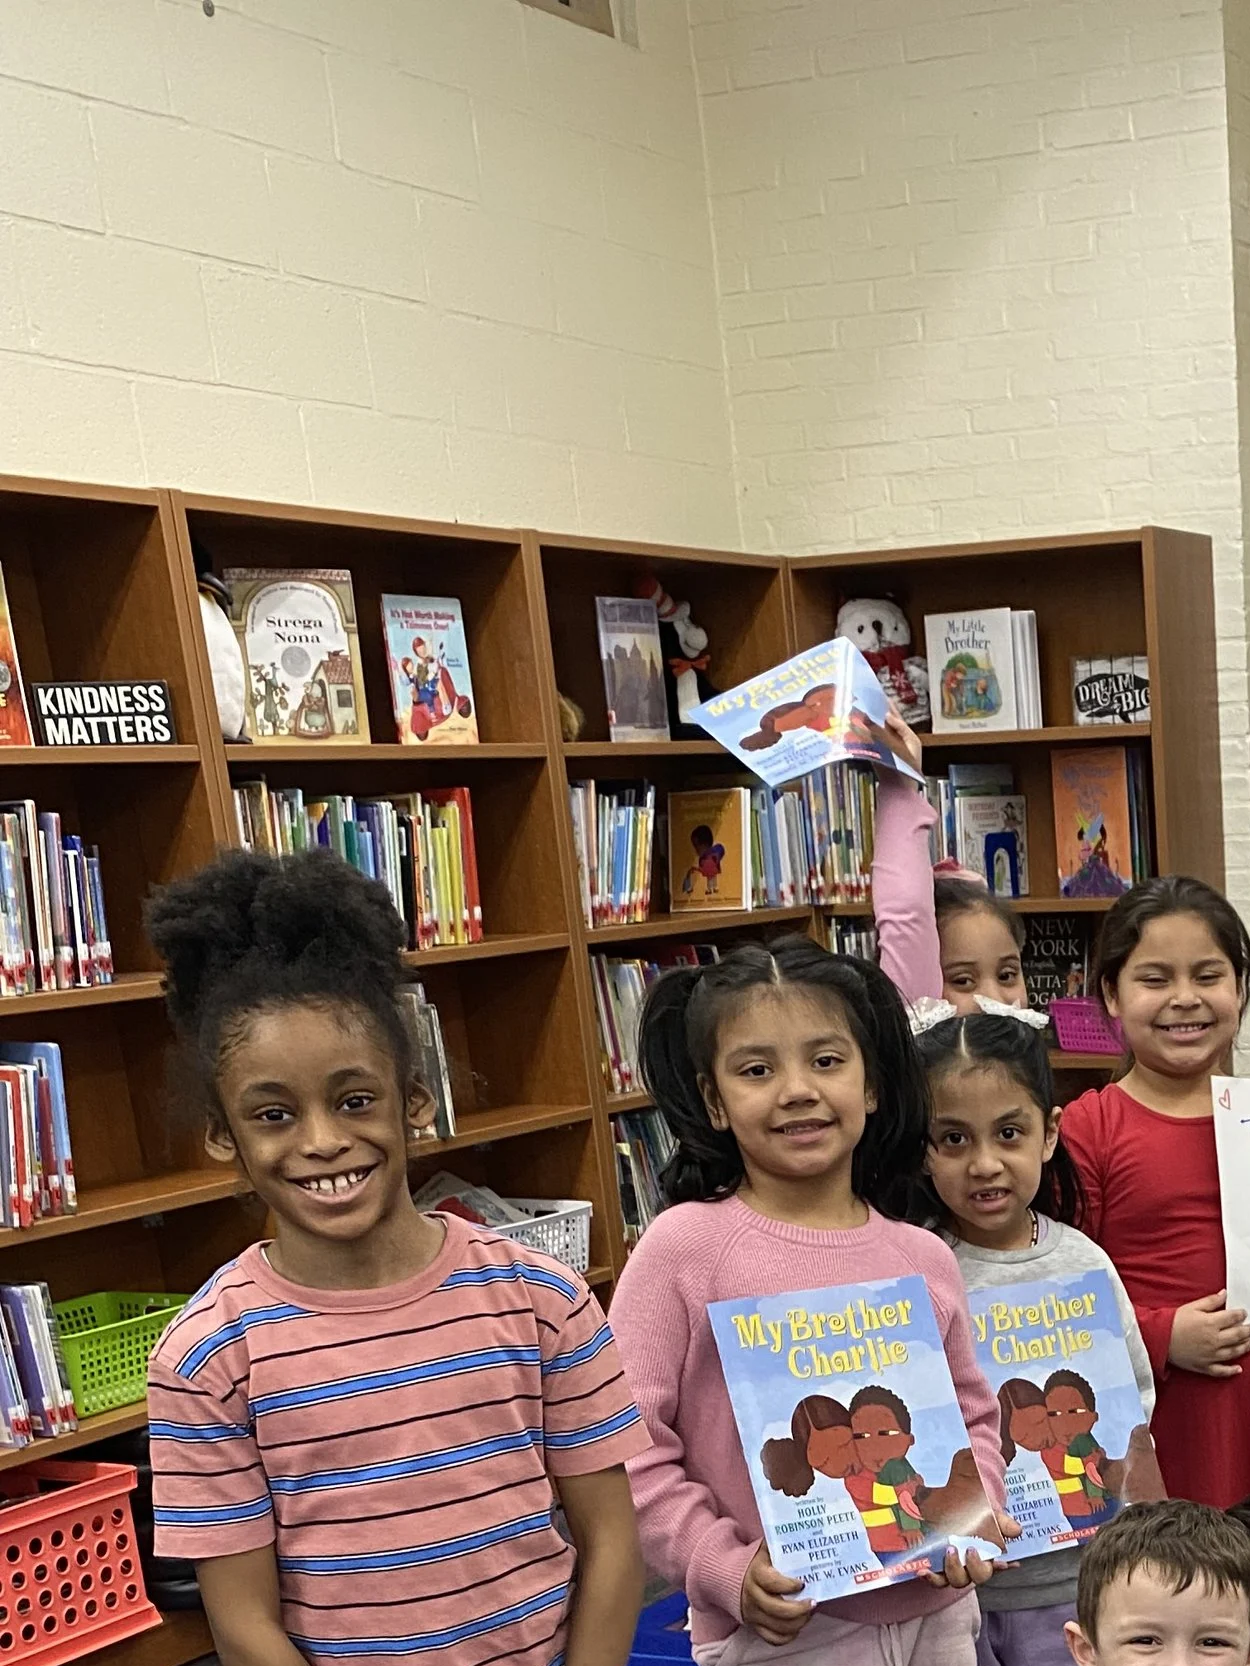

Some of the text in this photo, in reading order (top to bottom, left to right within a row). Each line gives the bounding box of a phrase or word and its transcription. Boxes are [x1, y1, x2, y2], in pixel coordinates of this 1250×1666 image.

[266, 616, 323, 630] Strega
[947, 618, 986, 636] My Little
[274, 632, 321, 644] Nona
[944, 631, 991, 653] Brother
[37, 685, 167, 715] KINDNESS
[1078, 674, 1134, 706] DREAM
[44, 715, 172, 746] MATTERS
[1031, 918, 1076, 936] NEW
[1029, 939, 1079, 957] YORK
[1027, 975, 1066, 989] ATTA-
[733, 1301, 913, 1354] My Brother
[975, 1295, 1096, 1339] y Brother
[992, 1324, 1093, 1364] Charlie
[788, 1336, 908, 1379] Charlie
[797, 1504, 828, 1518] HOLLY
[1011, 1496, 1054, 1513] ELIZABETH
[774, 1510, 856, 1535] ROBINSON PEETE
[1036, 1524, 1061, 1537] EVANS
[781, 1530, 858, 1554] RYAN ELIZABETH
[808, 1547, 838, 1561] PEETE
[789, 1572, 821, 1587] HANE
[836, 1562, 866, 1577] EVANS
